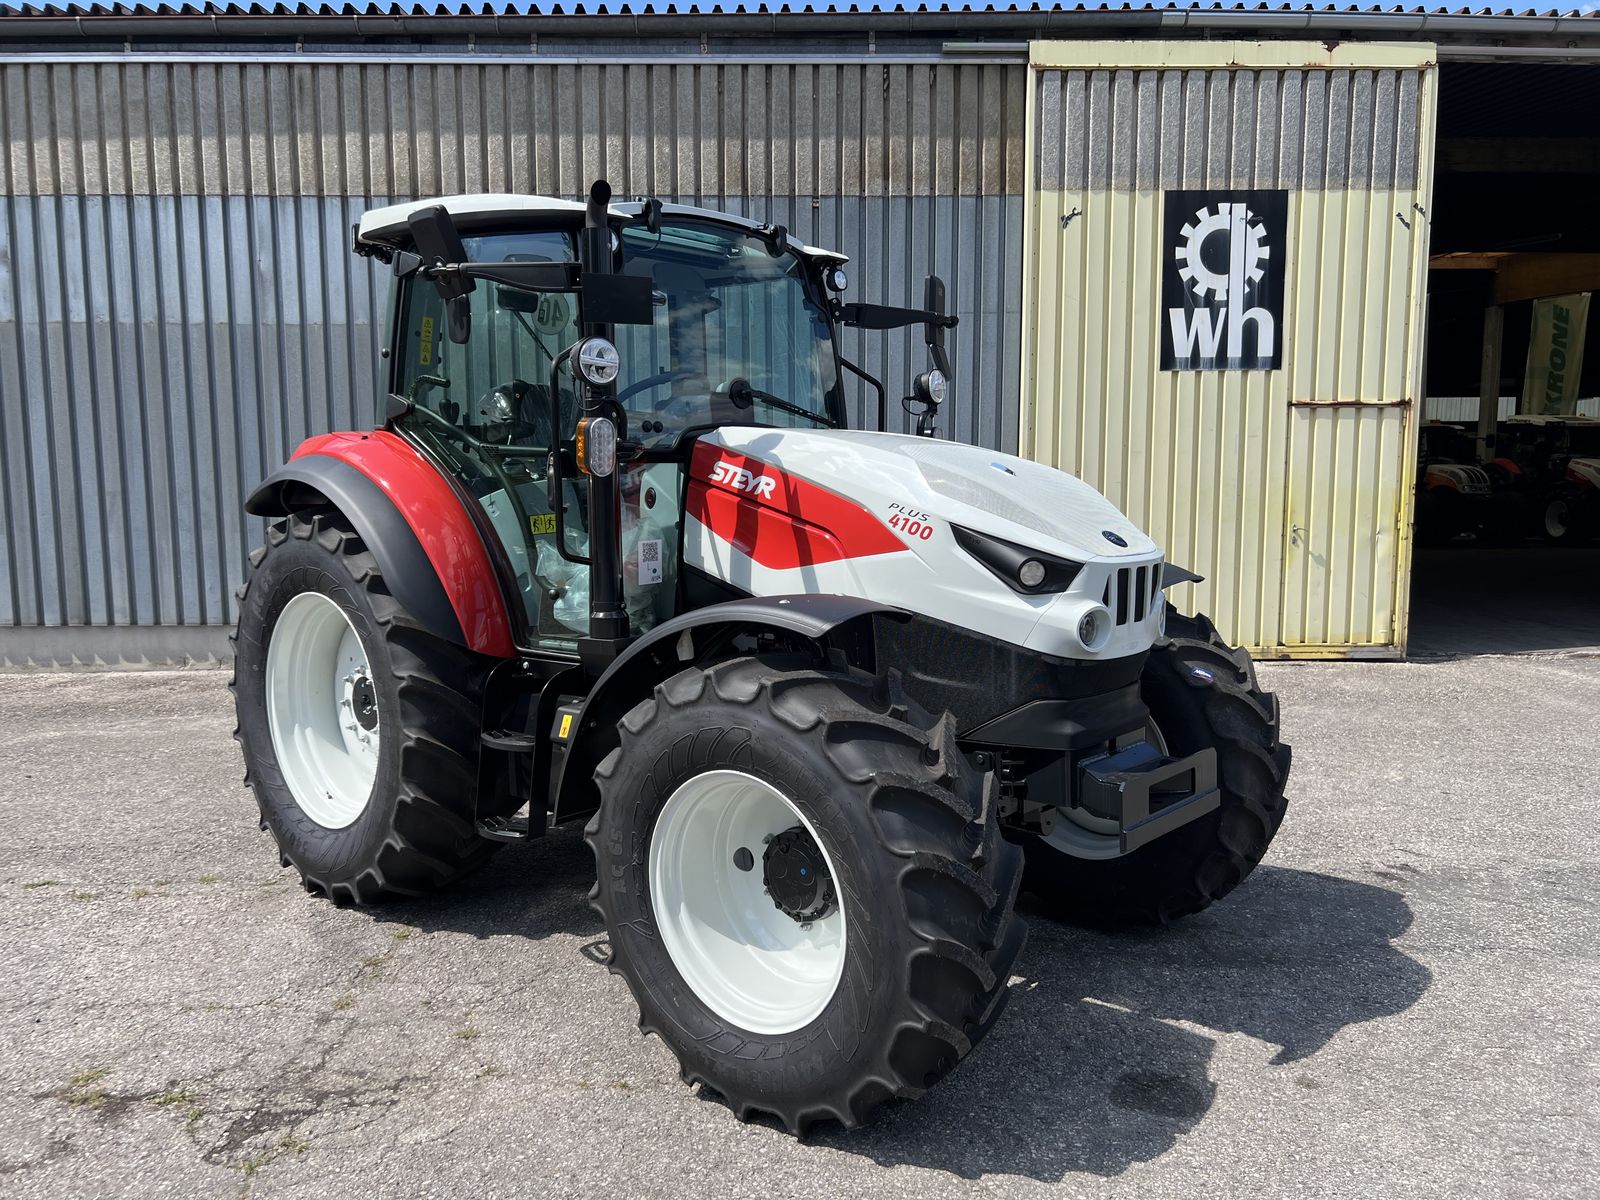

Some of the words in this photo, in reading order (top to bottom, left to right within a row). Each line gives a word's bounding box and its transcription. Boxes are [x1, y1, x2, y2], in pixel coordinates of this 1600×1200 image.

[1544, 304, 1570, 415] KRONE
[708, 461, 776, 500] STEYR
[888, 503, 930, 521] PLUS
[888, 514, 933, 540] 4100
